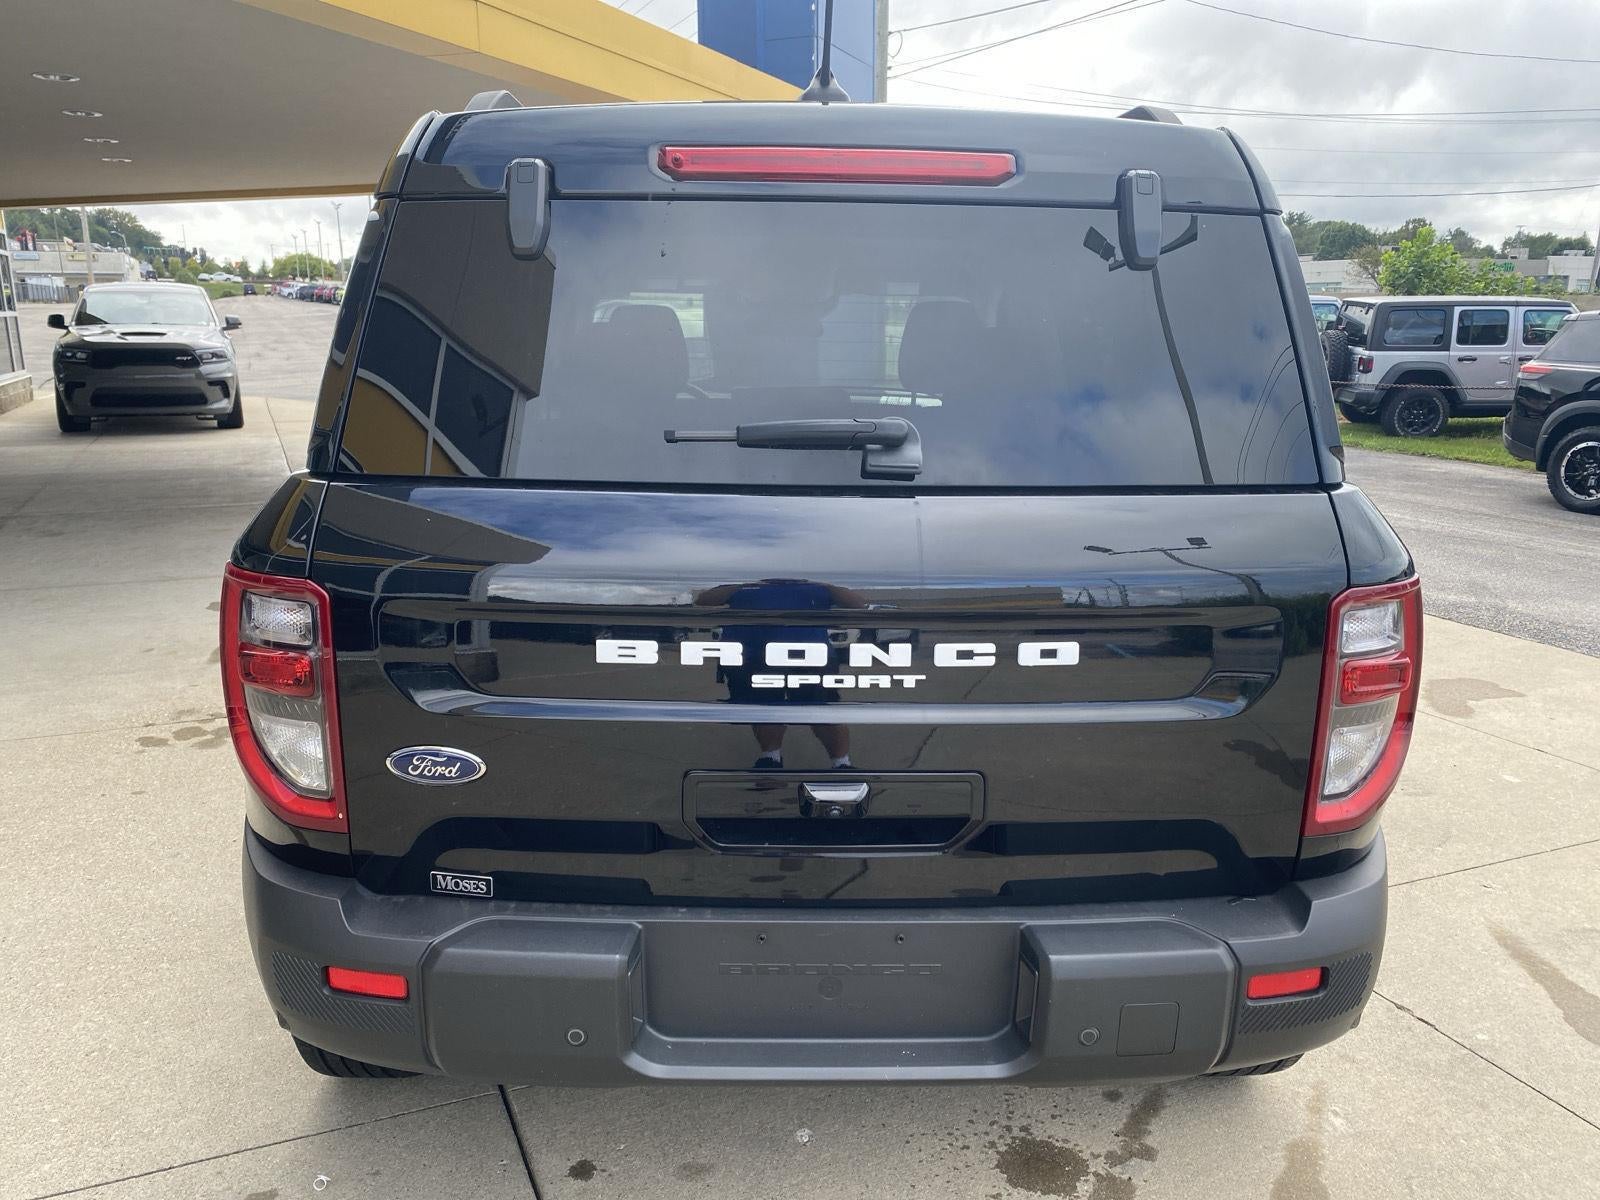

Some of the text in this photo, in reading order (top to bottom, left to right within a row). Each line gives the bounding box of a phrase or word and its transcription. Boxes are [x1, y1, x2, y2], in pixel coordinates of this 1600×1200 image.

[595, 639, 1080, 668] BRONCO
[751, 674, 927, 689] SPORT
[408, 755, 460, 777] Ford
[436, 874, 487, 893] MOSES
